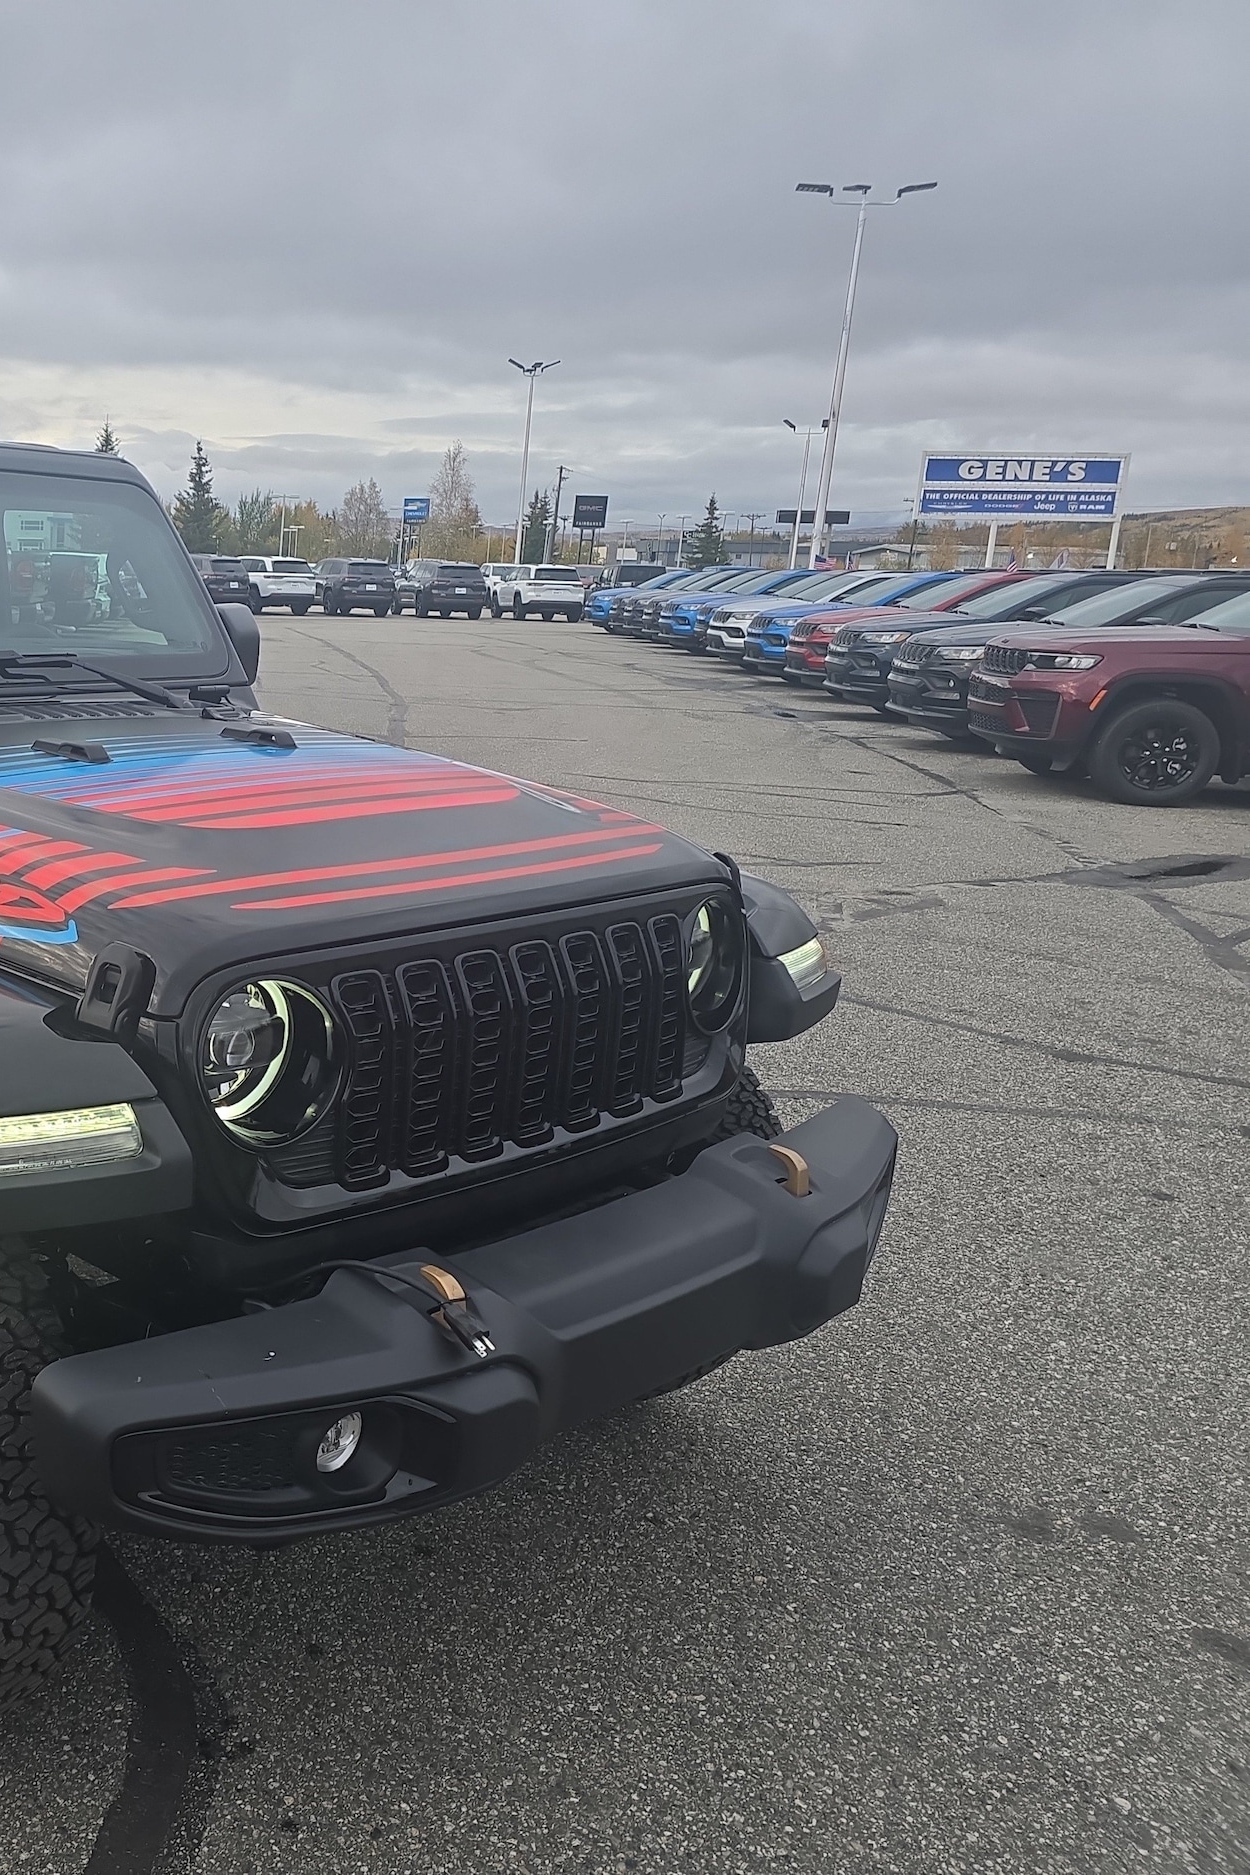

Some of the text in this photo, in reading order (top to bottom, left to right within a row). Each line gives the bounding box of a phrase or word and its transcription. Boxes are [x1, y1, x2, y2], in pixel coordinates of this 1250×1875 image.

[958, 460, 1087, 481] GENE'S
[925, 492, 941, 500] THE
[943, 492, 979, 501] OFFICIAL
[982, 493, 1032, 501] DEALERSHIP
[1035, 493, 1046, 501] OF
[1079, 494, 1112, 502] ALASKA
[1033, 502, 1056, 511] Jeep
